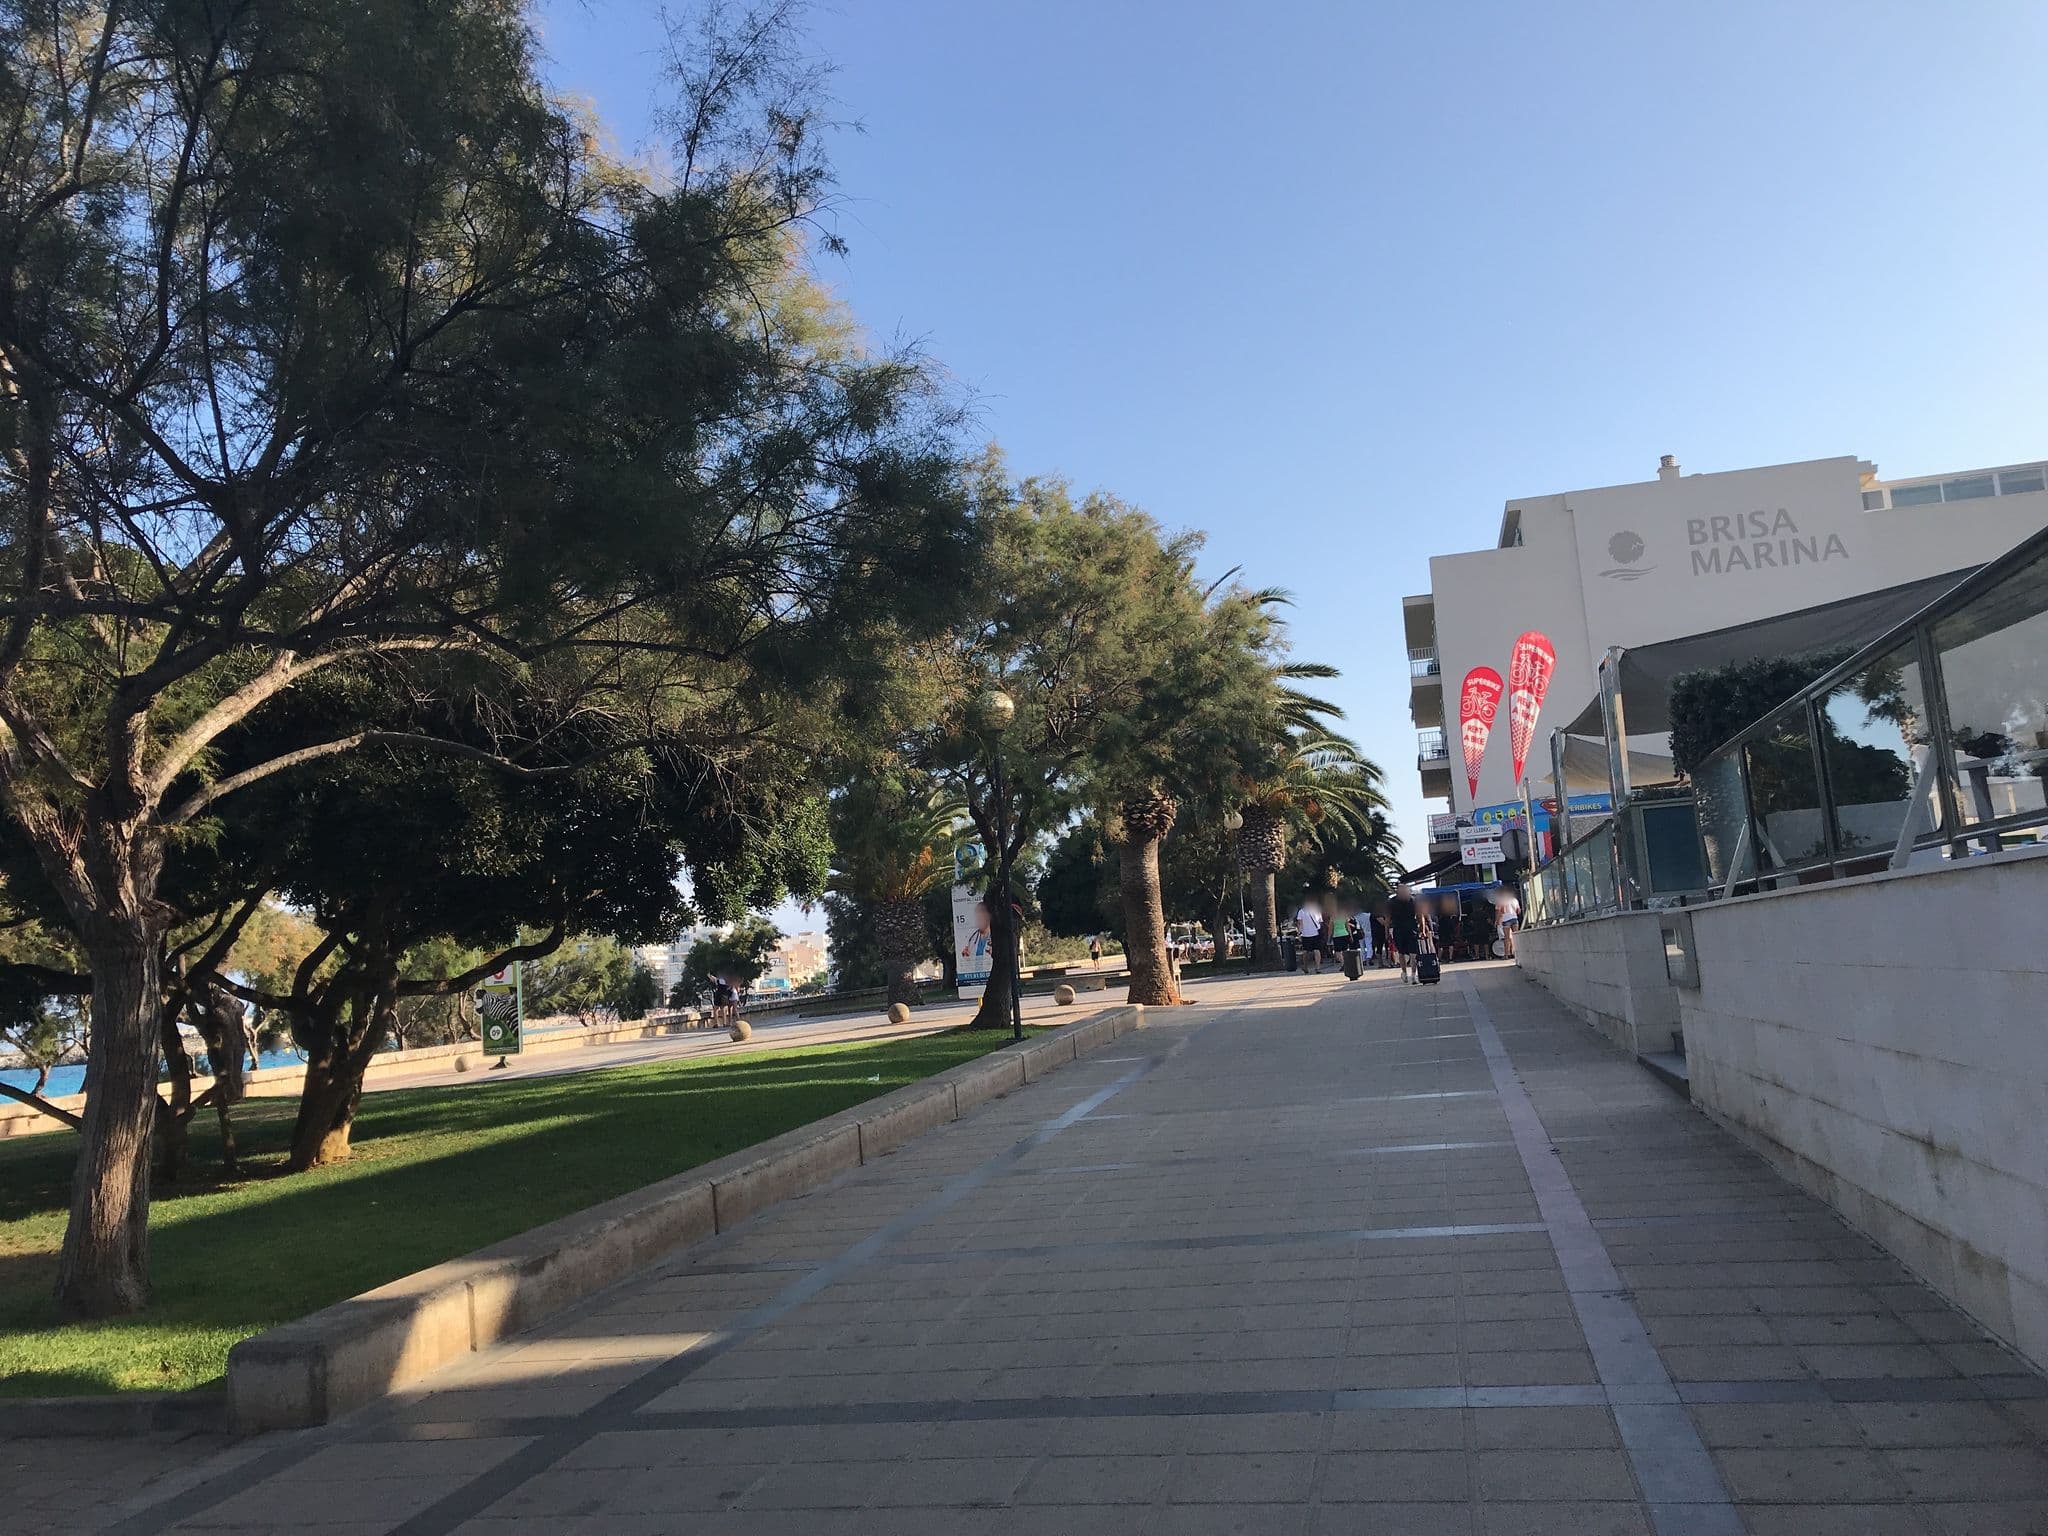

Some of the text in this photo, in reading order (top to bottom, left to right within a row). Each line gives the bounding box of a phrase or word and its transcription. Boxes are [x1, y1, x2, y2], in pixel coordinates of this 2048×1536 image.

[1687, 508, 1799, 545] BRISA
[1691, 533, 1849, 576] MARINA
[1519, 643, 1554, 665] SUPERBIKE
[1466, 677, 1501, 692] SUPERBIKE
[1471, 735, 1485, 745] BIKE
[956, 915, 965, 923] 15
